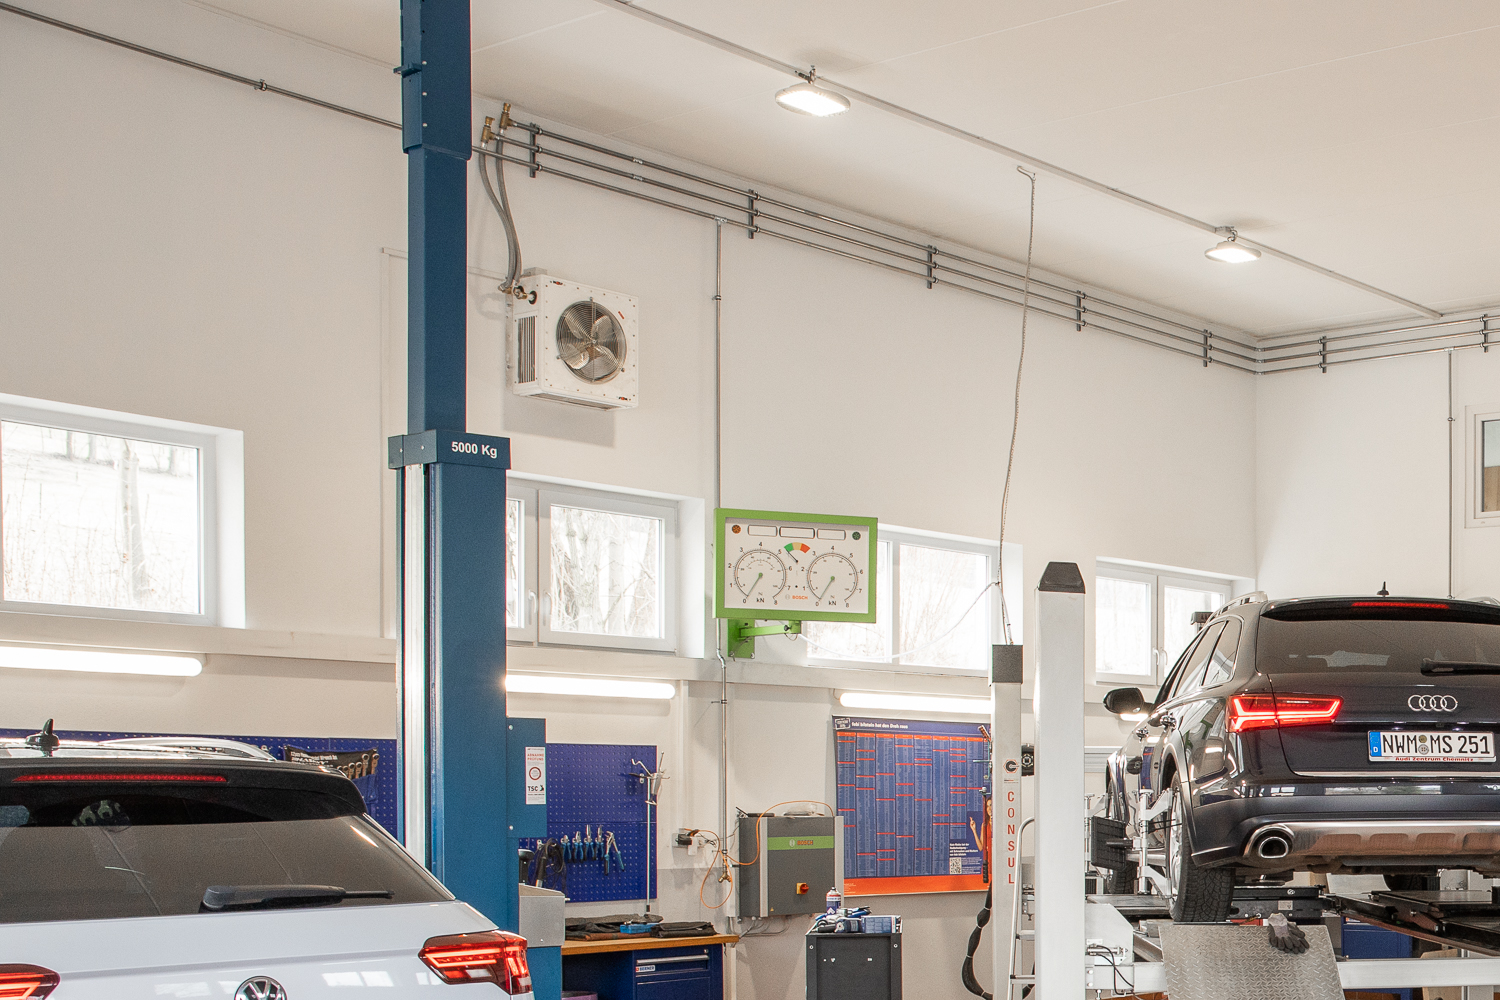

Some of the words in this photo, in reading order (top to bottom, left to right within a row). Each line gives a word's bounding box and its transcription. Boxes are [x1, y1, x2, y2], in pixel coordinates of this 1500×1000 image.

[451, 441, 478, 454] 5000
[481, 444, 498, 459] Kg
[1382, 734, 1418, 754] NWM
[1429, 734, 1453, 754] MS
[1457, 735, 1491, 754] 251
[1007, 791, 1015, 884] CONSUL
